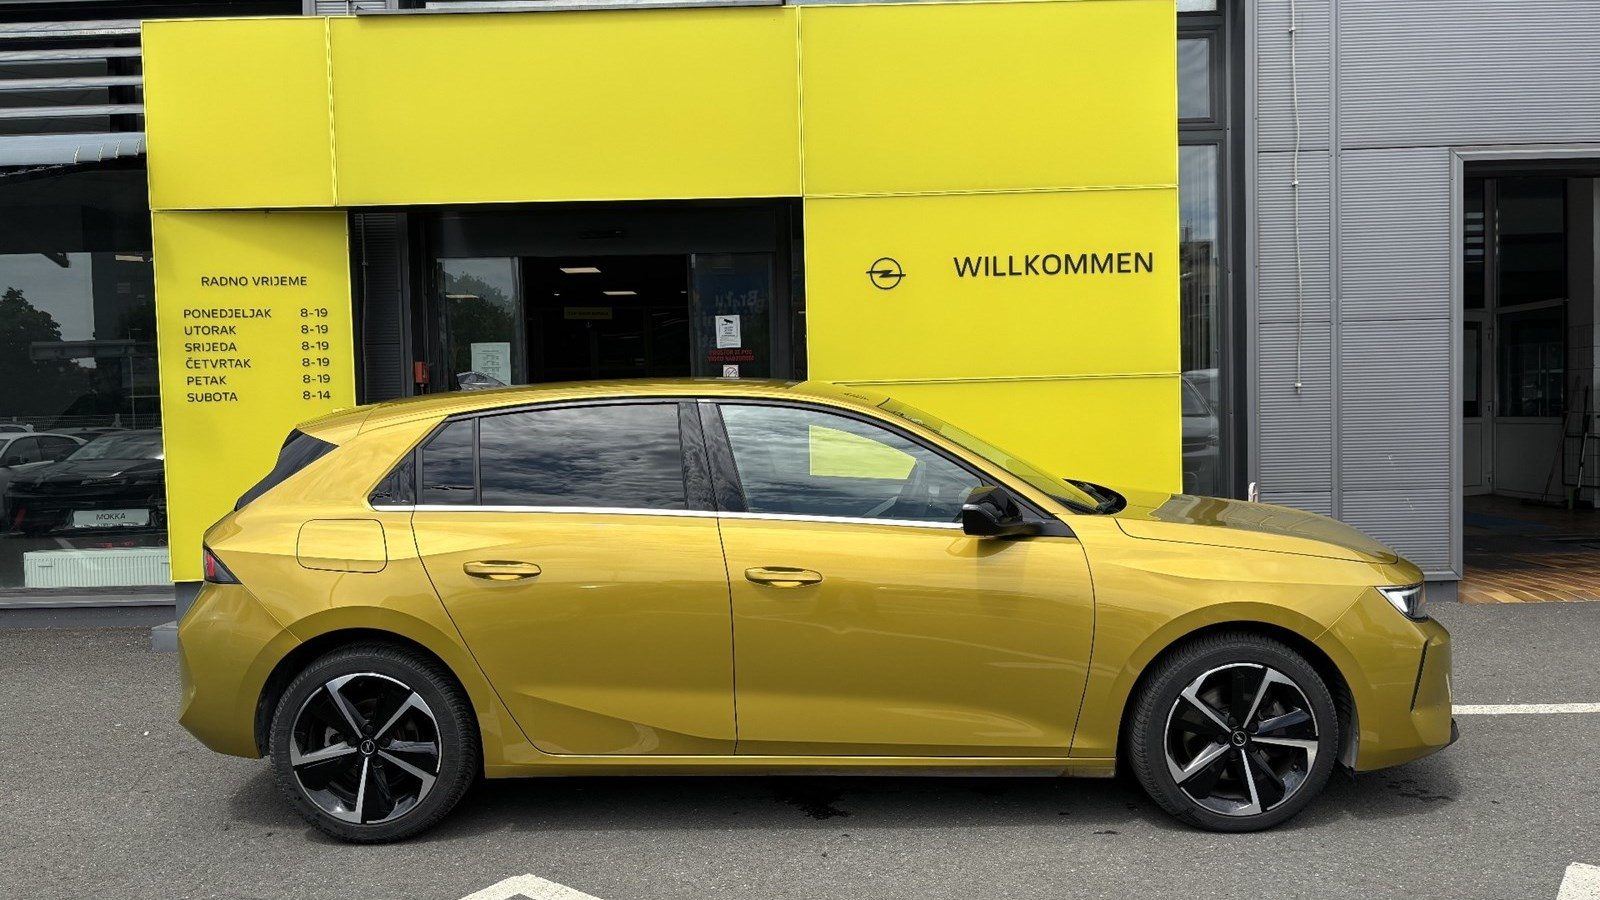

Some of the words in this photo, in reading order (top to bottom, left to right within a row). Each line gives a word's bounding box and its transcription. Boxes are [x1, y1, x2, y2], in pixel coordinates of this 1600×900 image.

[954, 252, 1152, 277] WILLKOMMEN
[202, 277, 248, 286] RADNO
[252, 277, 307, 286] VRIJEME
[184, 309, 271, 318] PONEDJELJAK
[301, 308, 327, 317] 8-19
[185, 326, 236, 335] UTORAK
[301, 325, 328, 334] 8-19
[185, 342, 236, 352] SRIJEDA
[302, 341, 329, 350] 8-19
[186, 357, 251, 369] ČETVRTAK
[303, 358, 329, 367] 8-19
[187, 376, 226, 385] PETAK
[303, 374, 330, 383] 8-19
[187, 392, 237, 402] SUBOTA
[303, 391, 331, 399] 8-14
